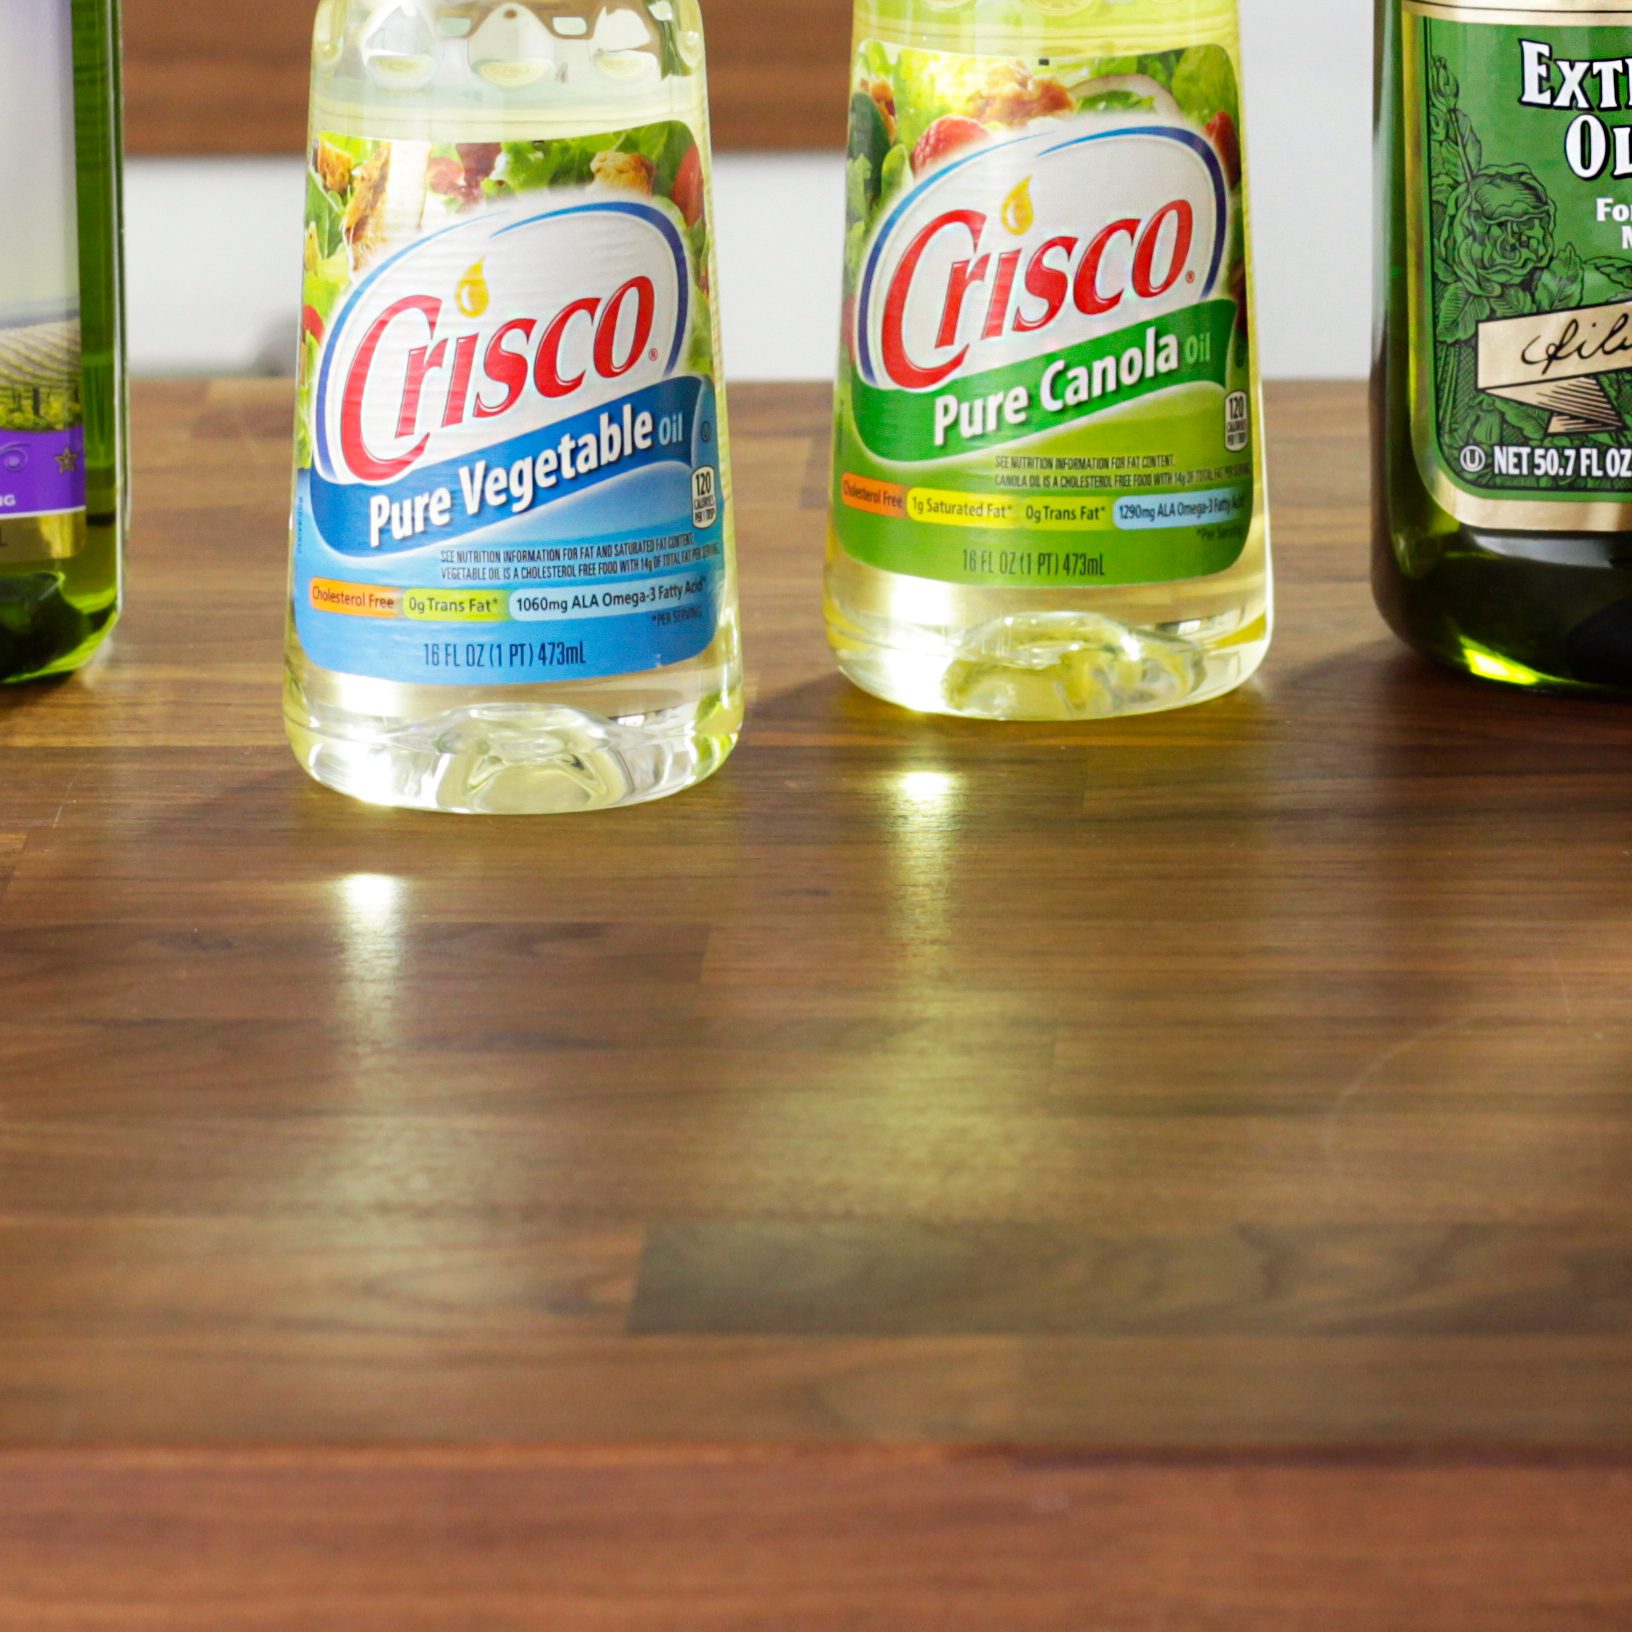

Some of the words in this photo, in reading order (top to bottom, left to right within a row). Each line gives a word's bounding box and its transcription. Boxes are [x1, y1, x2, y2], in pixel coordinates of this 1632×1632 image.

[880, 198, 1194, 390] Crisco
[340, 274, 655, 484] Crisco
[934, 385, 1030, 448] Pure
[1039, 325, 1180, 413] Canola
[368, 486, 453, 548] Pure
[457, 403, 654, 514] Vegetable
[1494, 445, 1532, 476] NET
[1533, 449, 1576, 476] 50.7
[1579, 447, 1603, 477] FL
[1605, 448, 1632, 478] OZ
[911, 496, 925, 515] 1g
[926, 497, 985, 518] Saturated
[1025, 505, 1042, 524] 0g
[1043, 506, 1077, 521] Trans
[312, 585, 367, 608] Cholesterol
[368, 594, 395, 609] Free
[408, 597, 426, 615] 0g
[428, 597, 466, 613] Trans
[516, 597, 569, 614] 1060mg
[571, 594, 600, 610] ALA
[602, 586, 657, 608] Omega-3
[658, 580, 684, 601] Fatty
[423, 643, 440, 667] 16
[444, 643, 462, 668] FL
[465, 643, 486, 668] OZ
[489, 643, 503, 668] (1
[508, 641, 535, 669] PT)
[537, 641, 587, 667] 473mL
